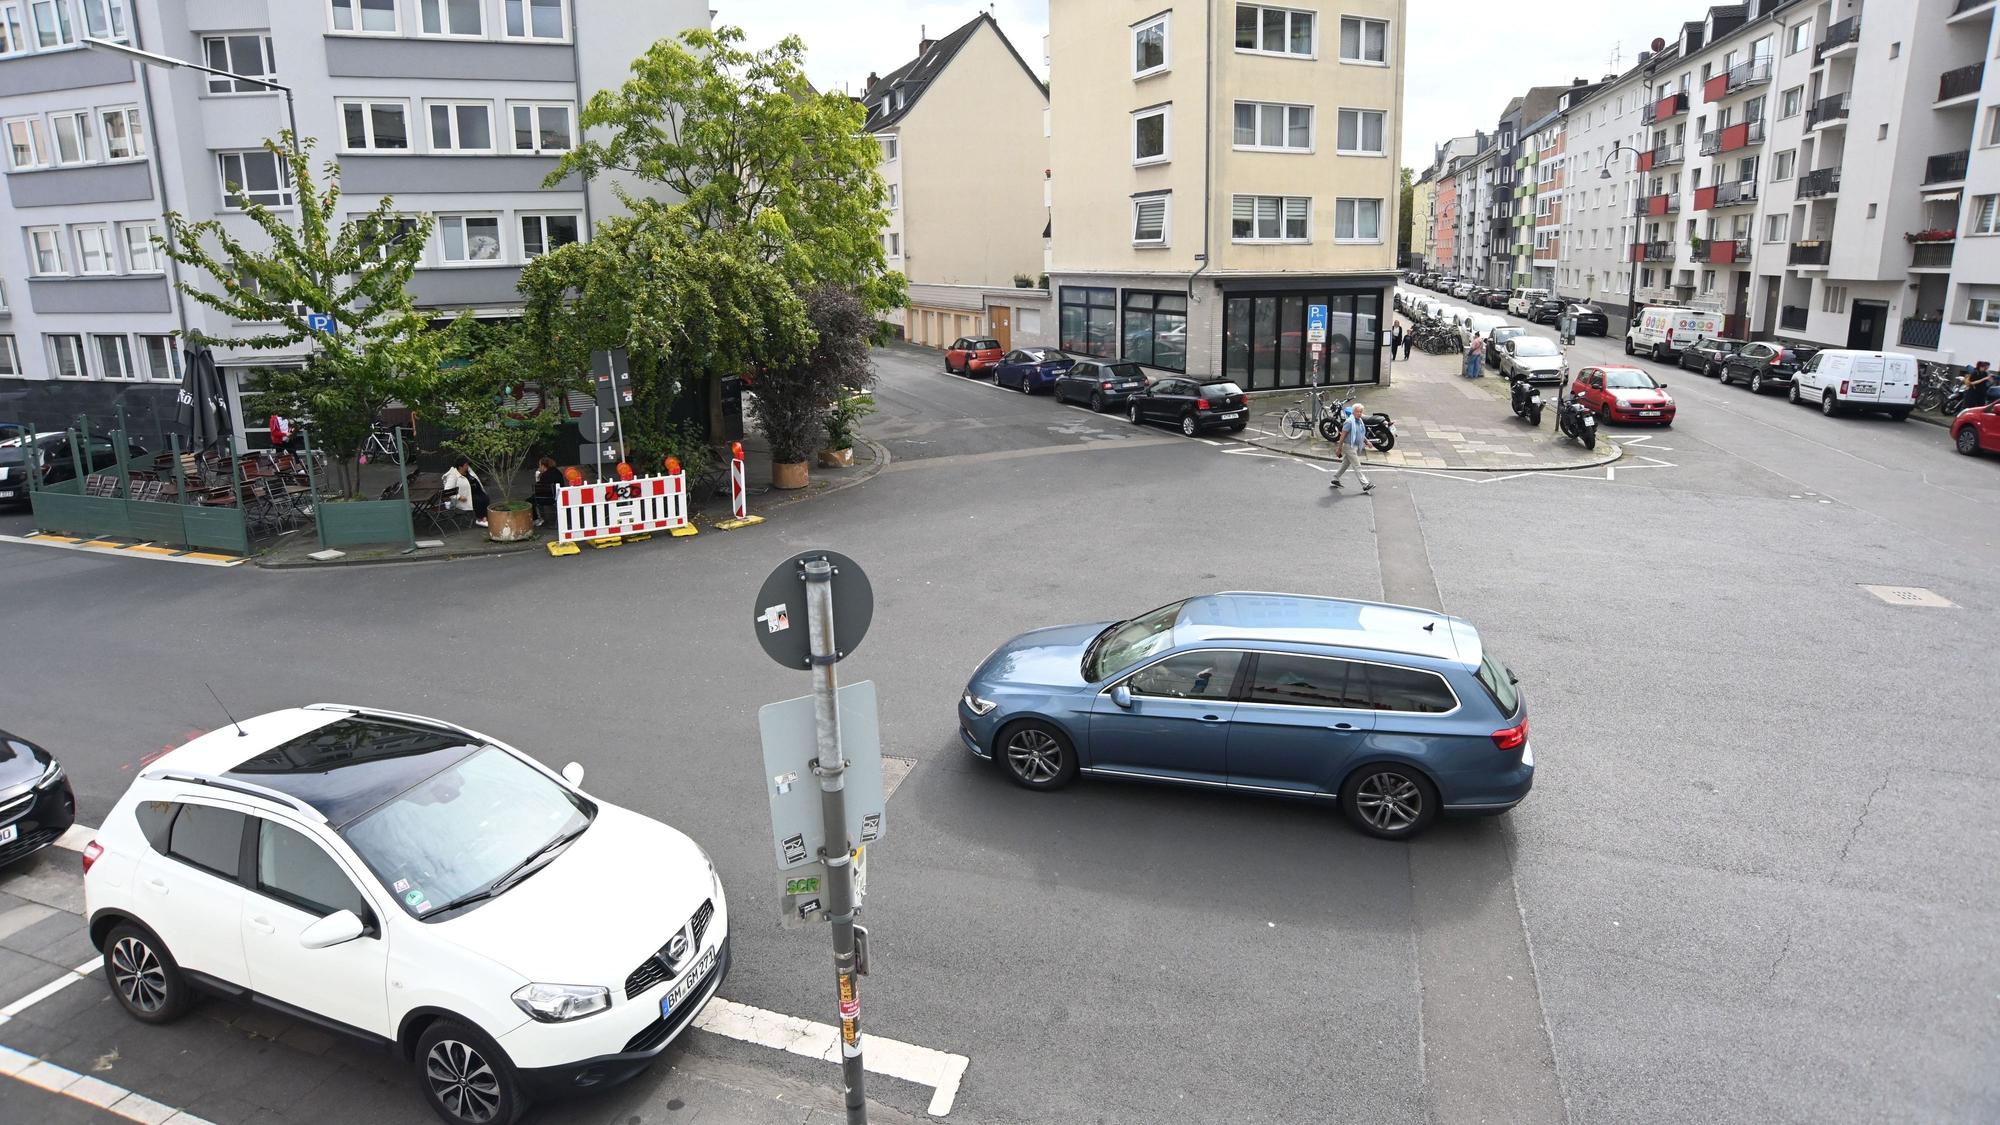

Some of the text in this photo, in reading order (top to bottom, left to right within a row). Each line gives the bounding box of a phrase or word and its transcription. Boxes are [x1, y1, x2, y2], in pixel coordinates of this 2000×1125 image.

[1311, 306, 1319, 318] P
[314, 316, 328, 331] P
[668, 951, 714, 1008] BM GM 271
